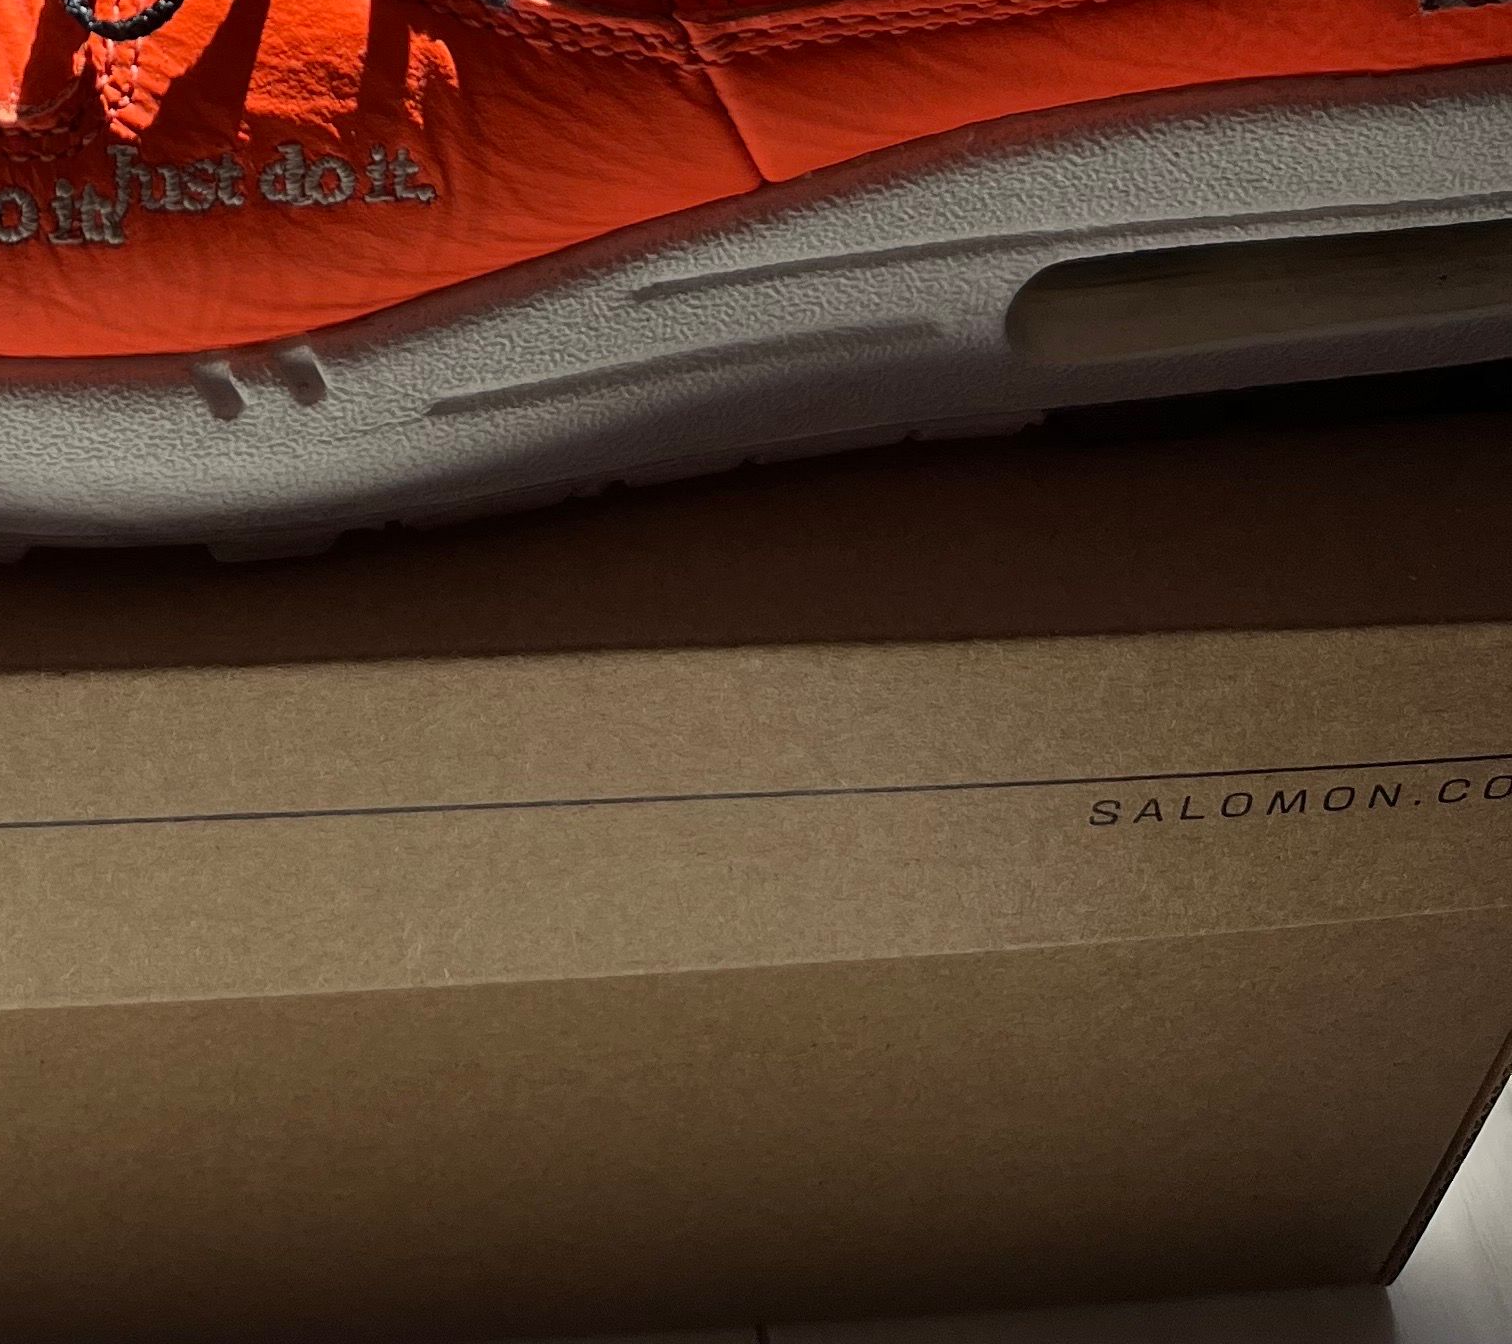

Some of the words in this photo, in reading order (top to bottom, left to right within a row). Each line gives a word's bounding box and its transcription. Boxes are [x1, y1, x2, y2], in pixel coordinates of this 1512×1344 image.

[106, 145, 245, 222] Just
[260, 144, 356, 205] do
[1089, 775, 1512, 826] SALOMON.CO
